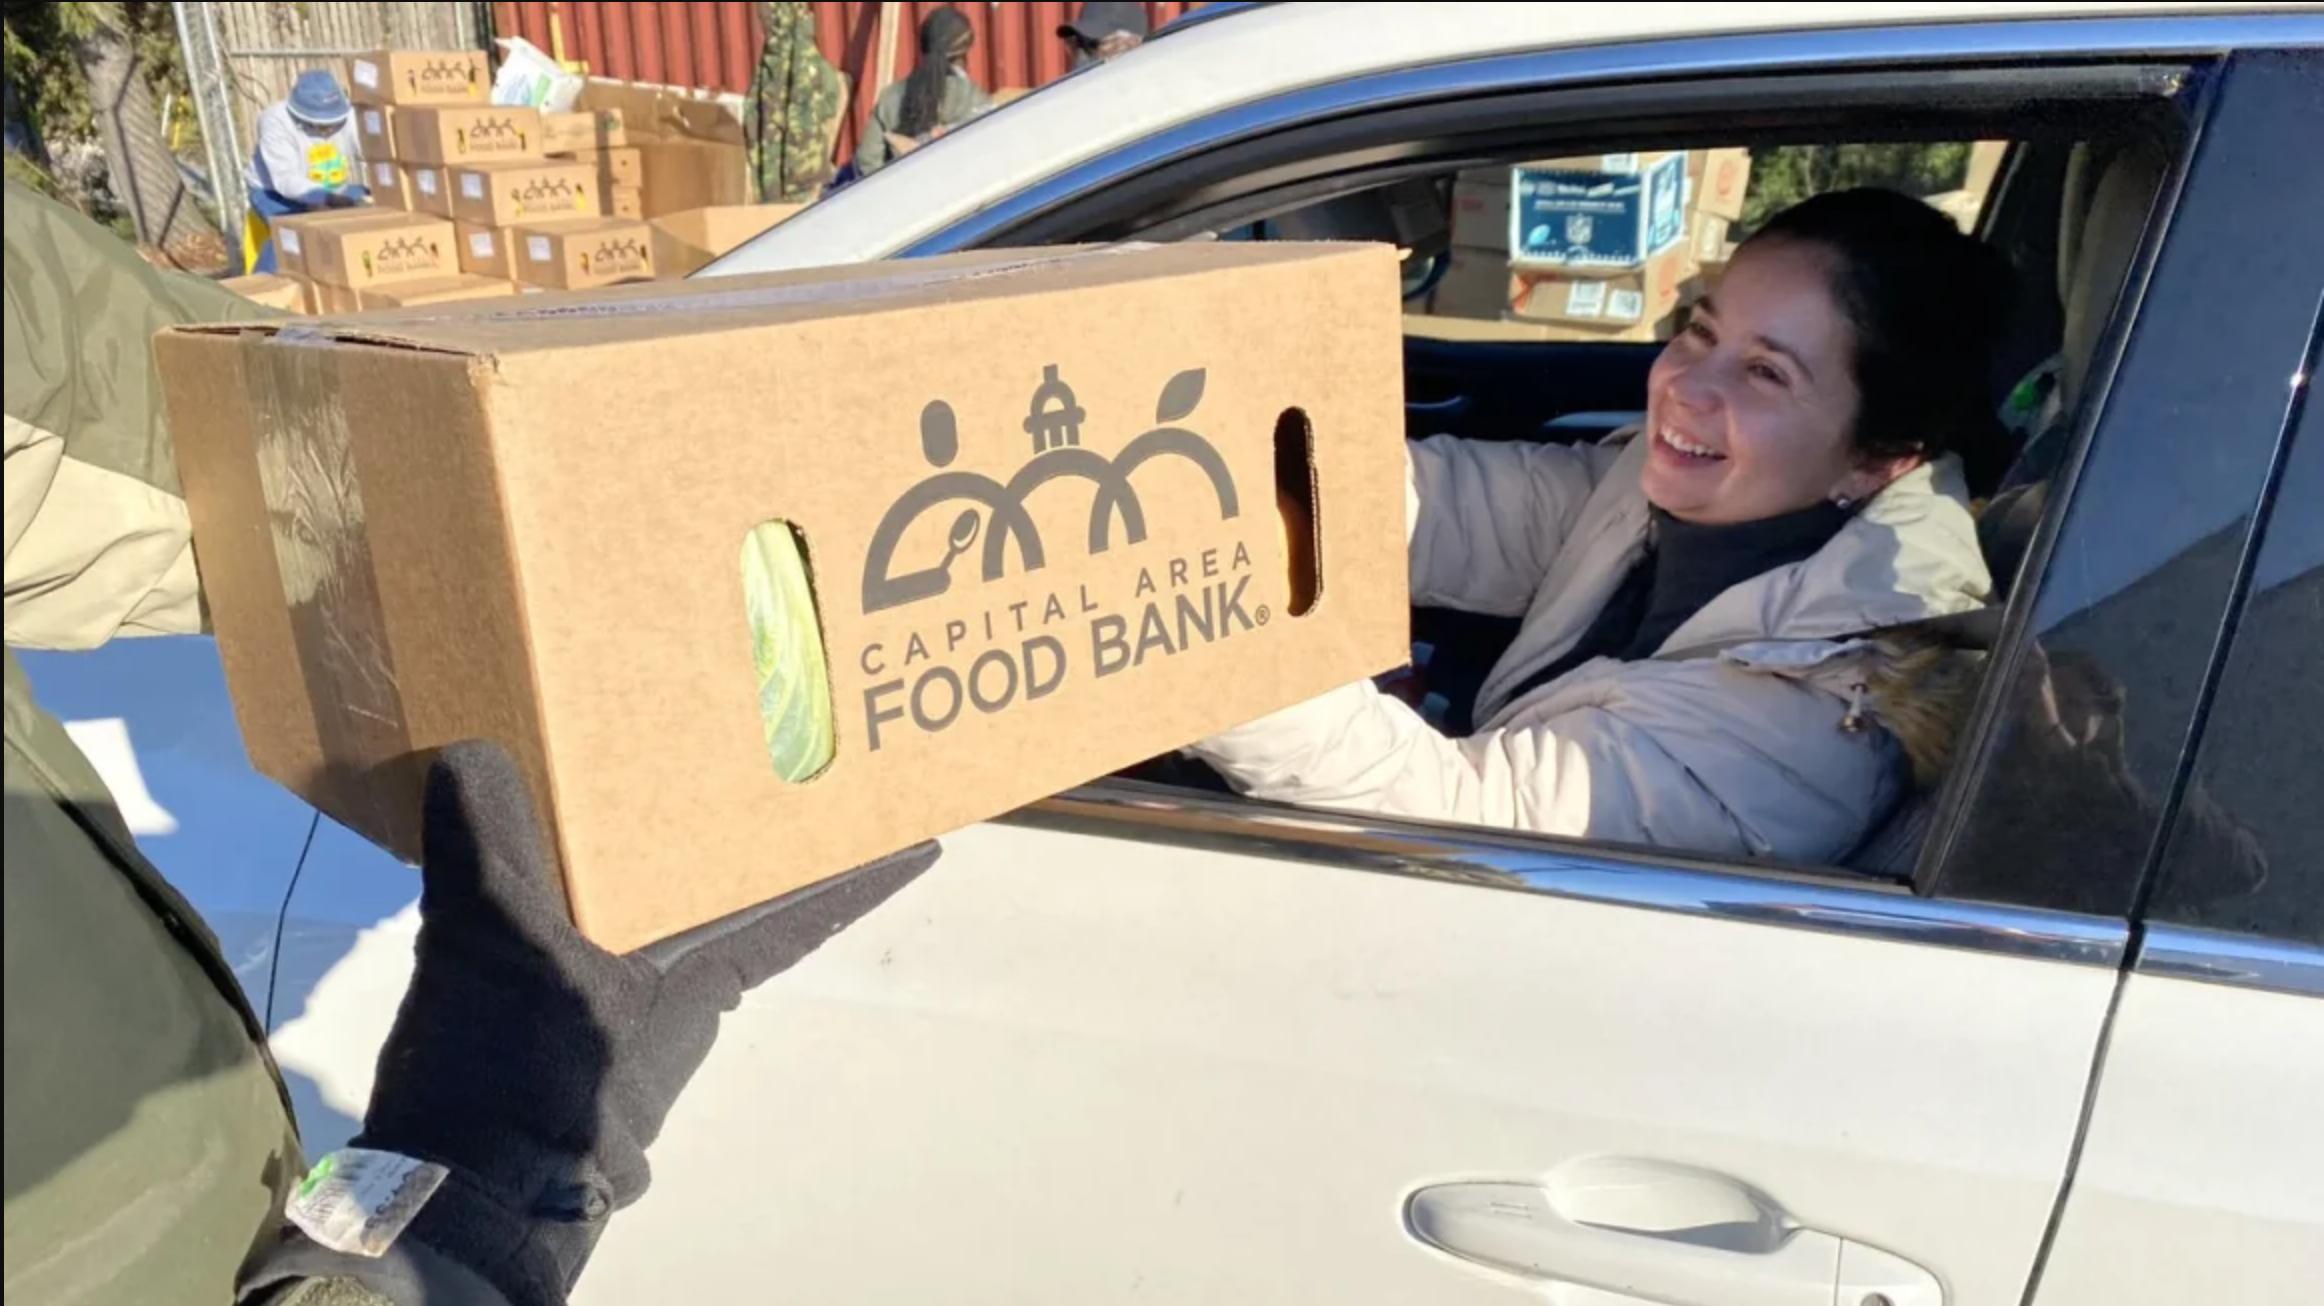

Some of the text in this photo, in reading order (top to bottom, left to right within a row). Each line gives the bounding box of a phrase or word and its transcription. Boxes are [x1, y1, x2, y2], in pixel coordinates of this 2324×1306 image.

[860, 540, 1252, 676] CAPITAL AREA
[862, 634, 1068, 753] FOOD
